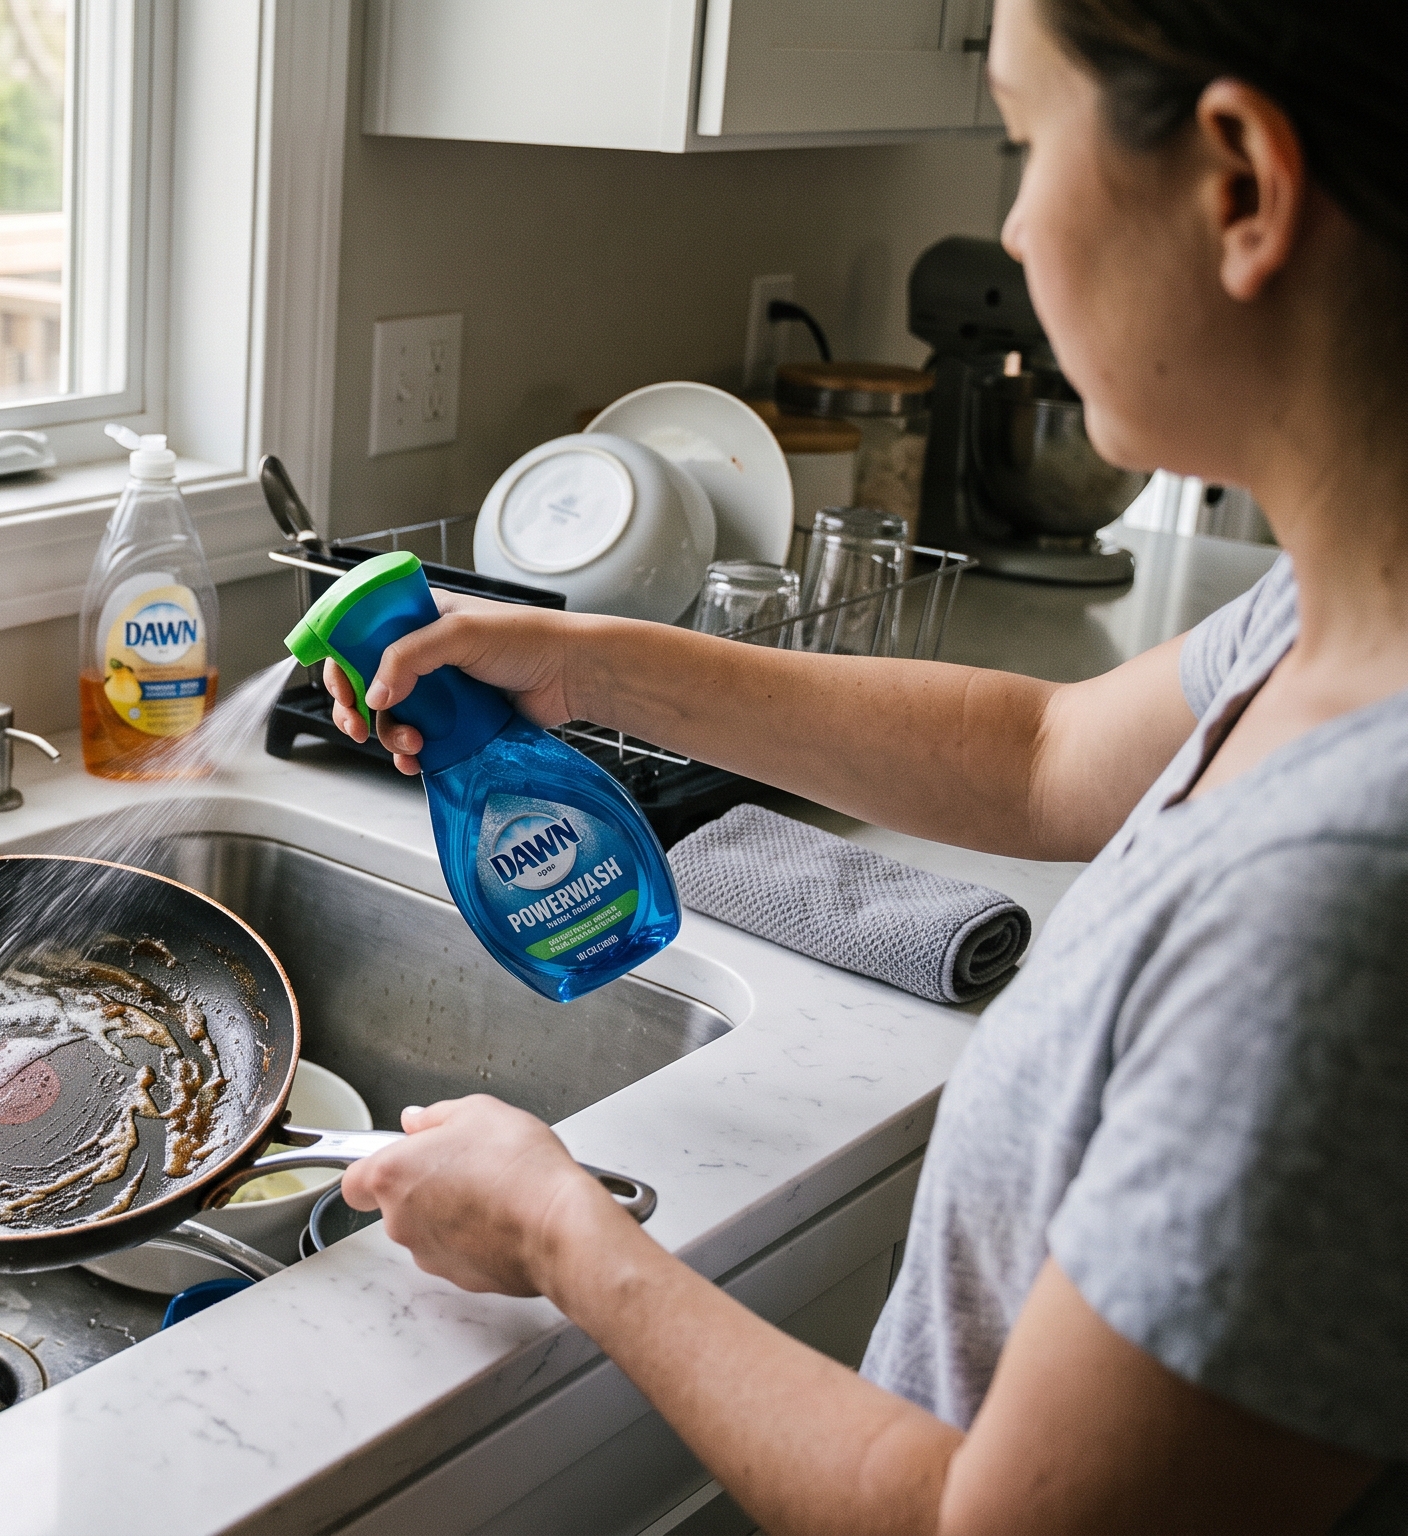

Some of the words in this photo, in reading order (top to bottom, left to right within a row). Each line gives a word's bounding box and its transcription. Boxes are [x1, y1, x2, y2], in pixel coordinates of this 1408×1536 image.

[125, 619, 197, 647] DAWN
[489, 817, 580, 884] DAWN
[507, 856, 623, 933] POWERWASH
